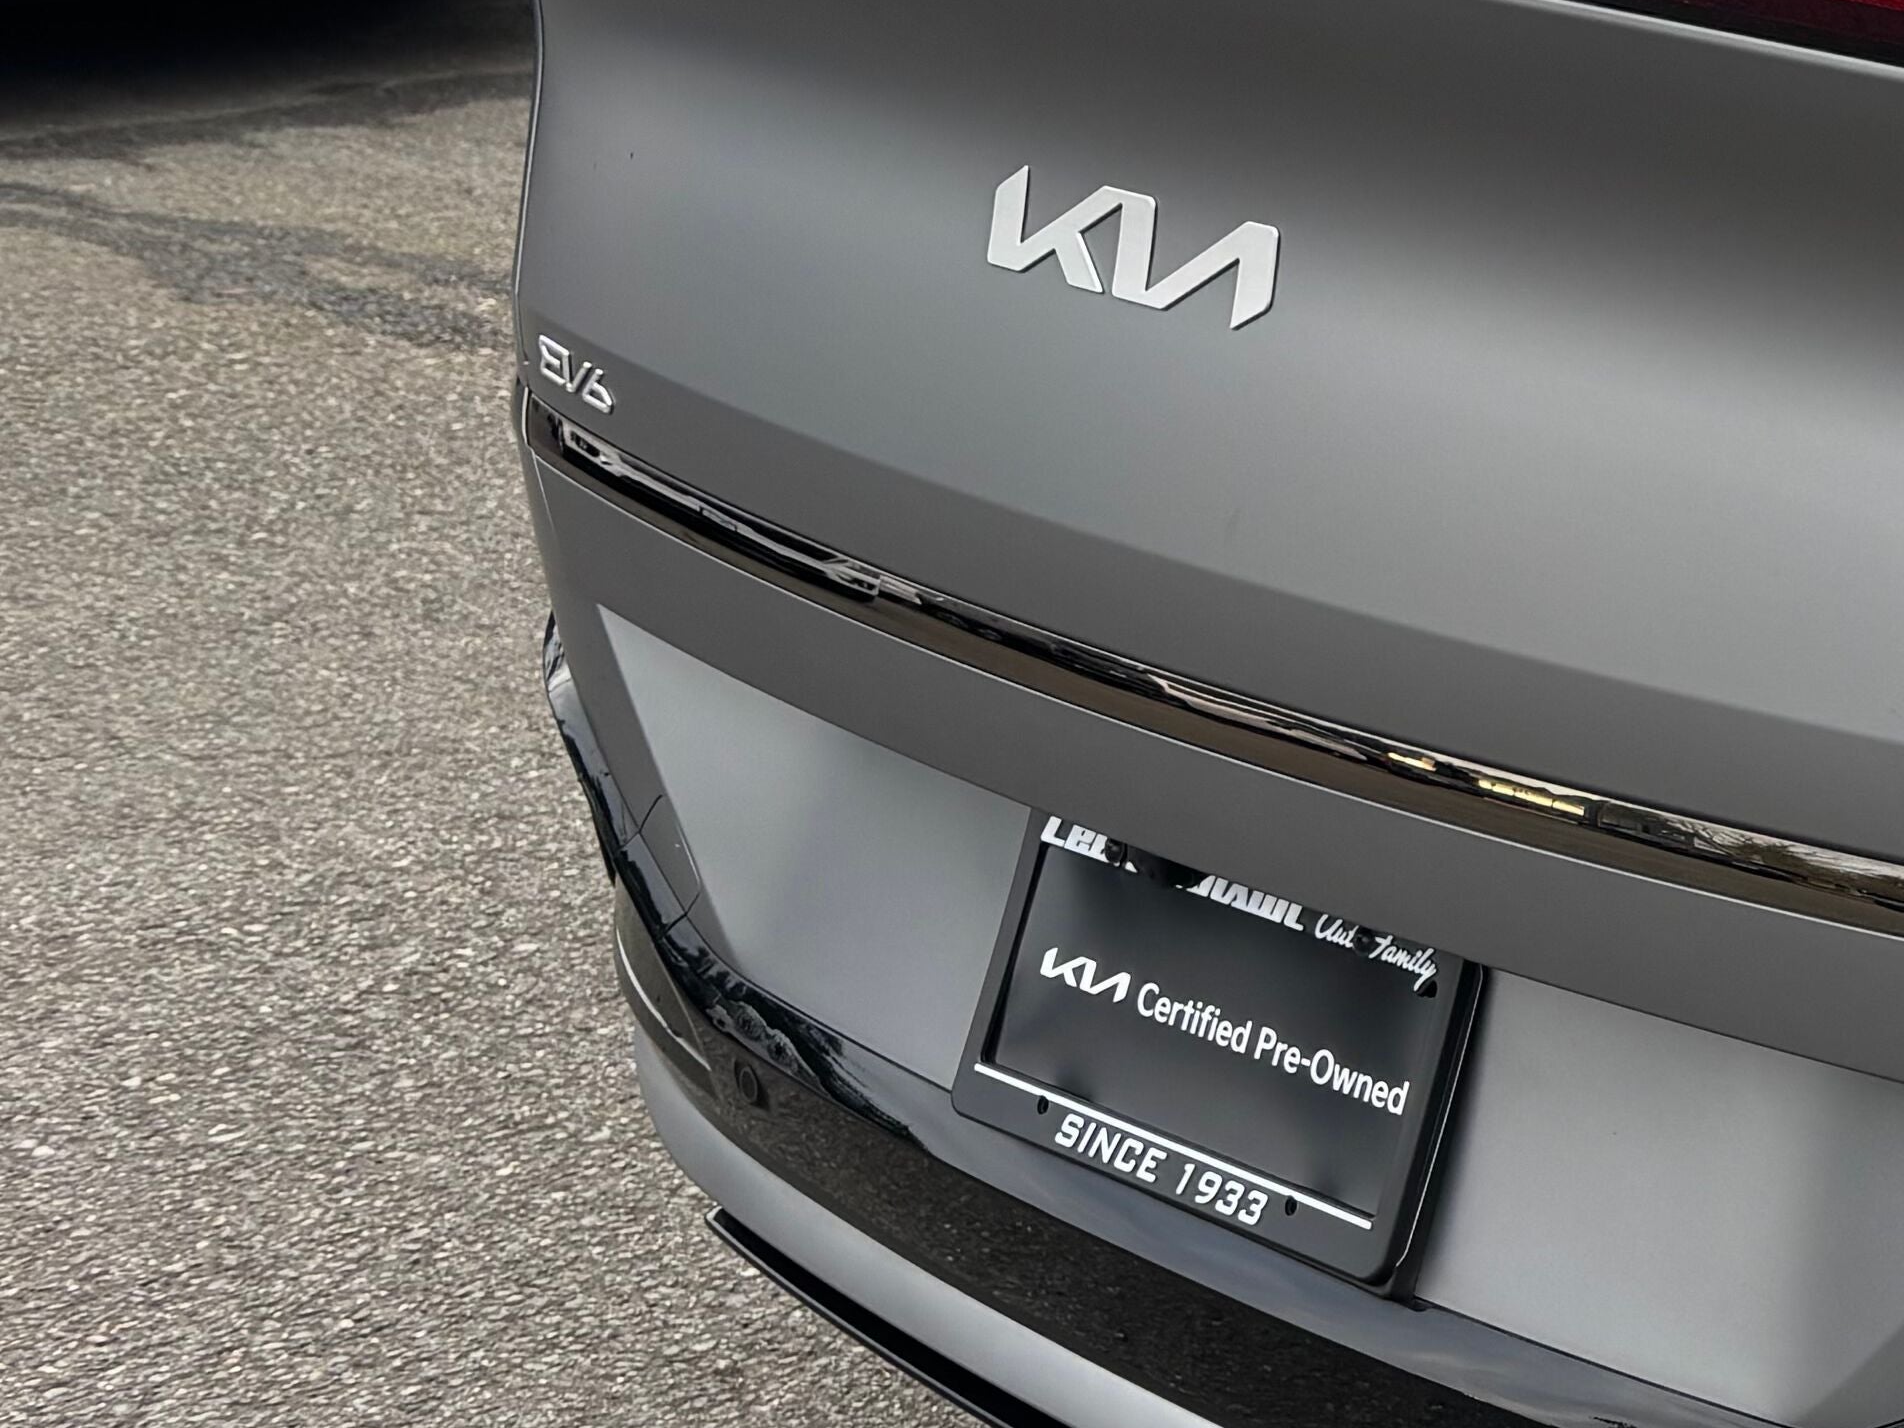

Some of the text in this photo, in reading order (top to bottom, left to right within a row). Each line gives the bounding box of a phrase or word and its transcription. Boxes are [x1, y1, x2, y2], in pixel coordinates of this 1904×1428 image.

[987, 164, 1280, 330] KIA
[538, 334, 615, 414] EV6
[1315, 913, 1362, 948] Aut
[1039, 947, 1410, 1115] KIA Certified Pre-Owned
[1054, 1112, 1268, 1225] SINCE 1933
